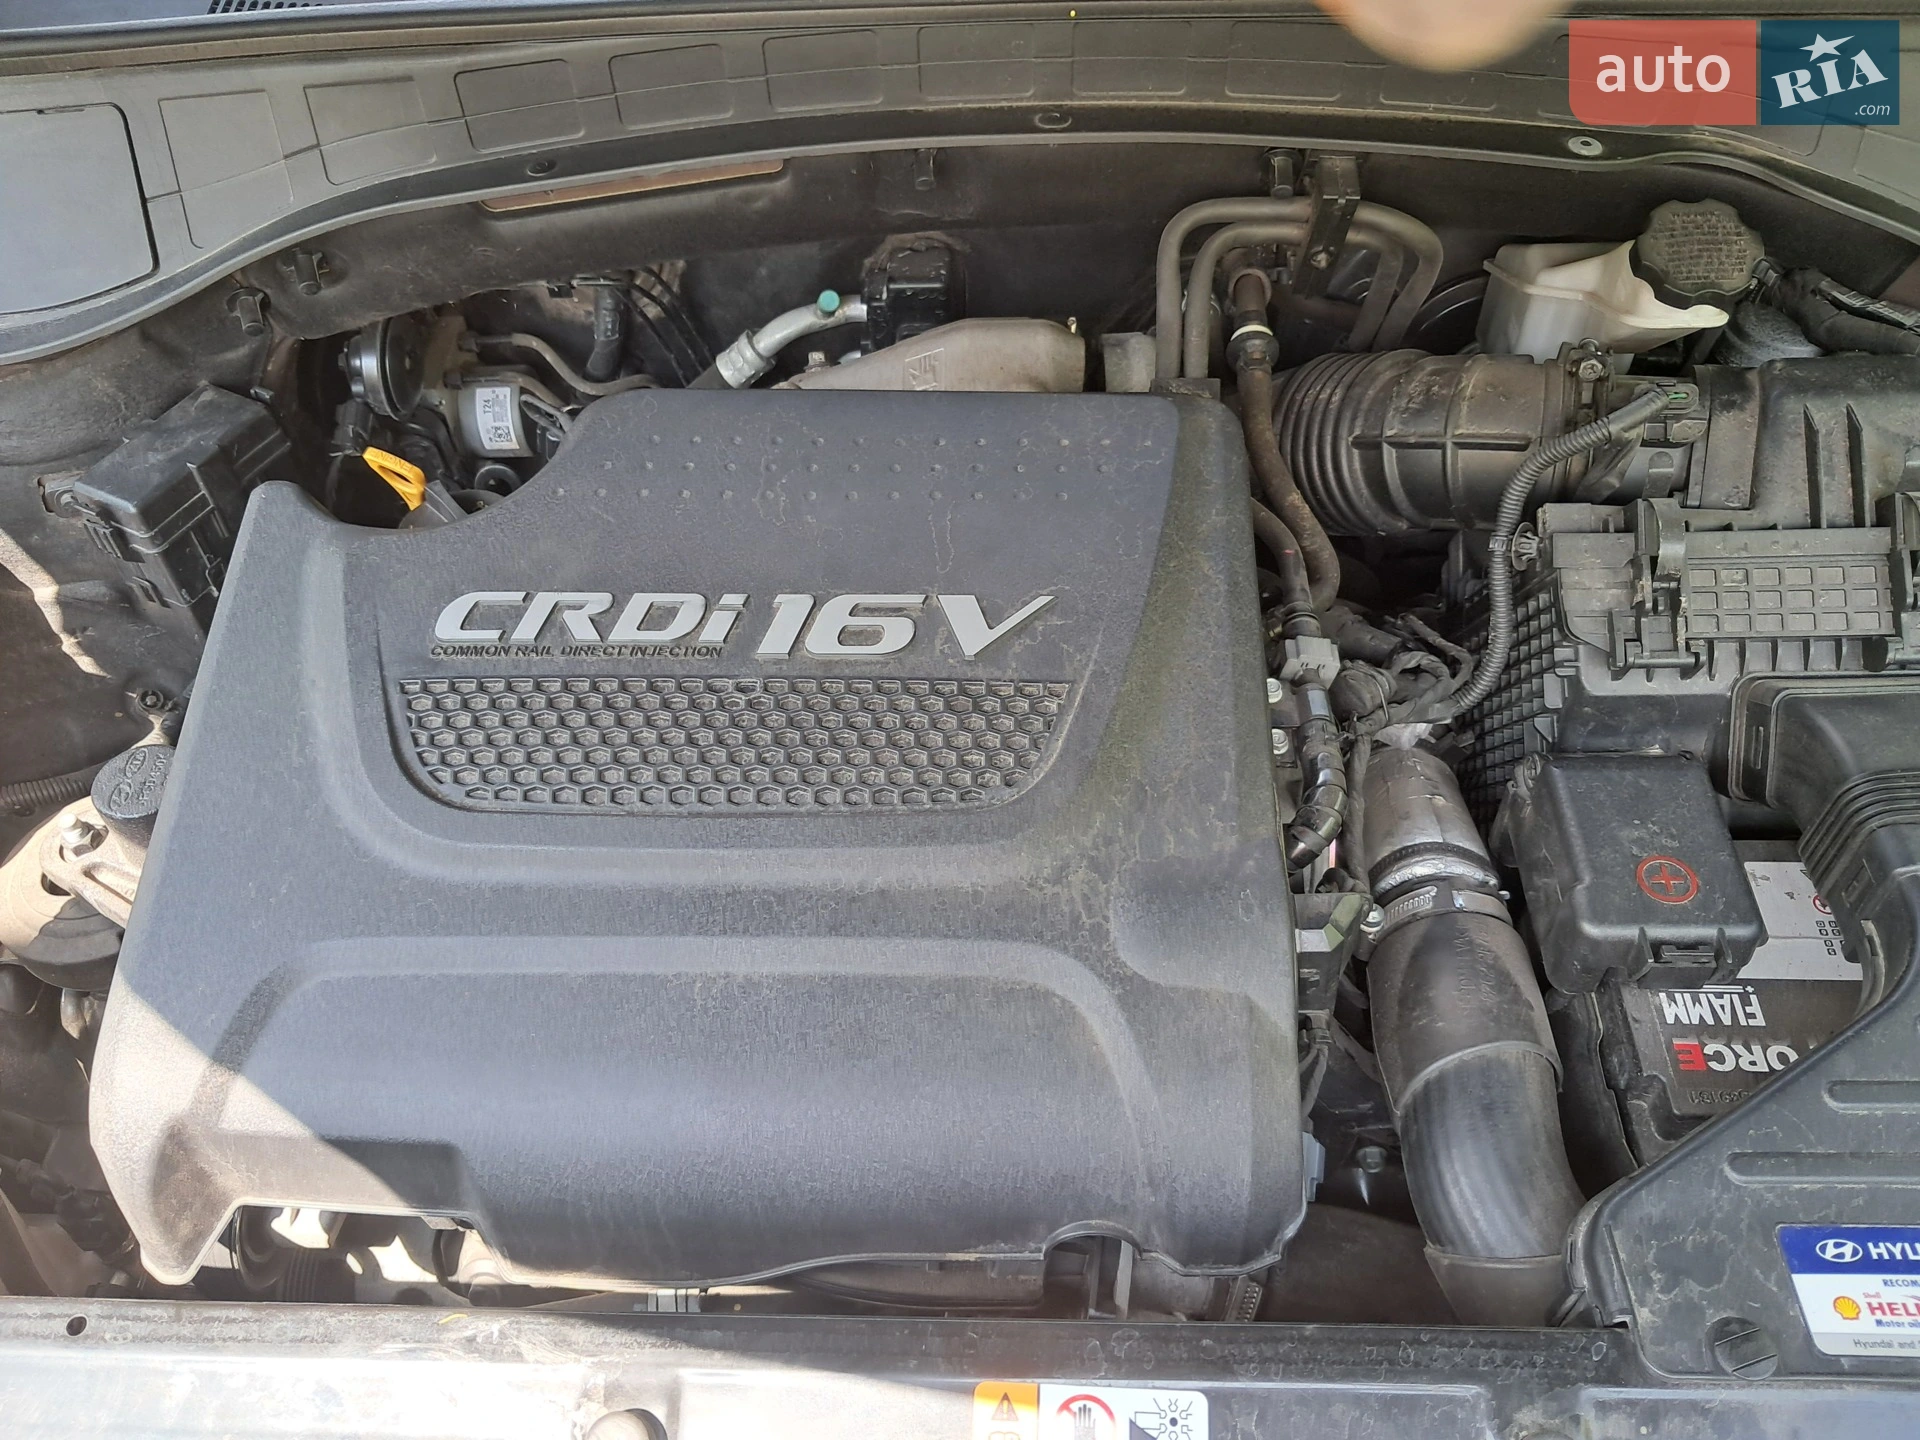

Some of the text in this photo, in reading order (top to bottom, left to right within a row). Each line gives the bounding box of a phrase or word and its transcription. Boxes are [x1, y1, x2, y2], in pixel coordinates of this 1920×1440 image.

[434, 591, 748, 643] CRDi
[430, 645, 724, 658] COMMON RAIL DIRECT INJECTION
[1658, 992, 1766, 1027] FIAMM
[1673, 1040, 1811, 1072] ORCE
[1874, 1318, 1905, 1328] Motor
[1853, 1338, 1894, 1350] Hyundai
[1897, 1340, 1916, 1350] and
